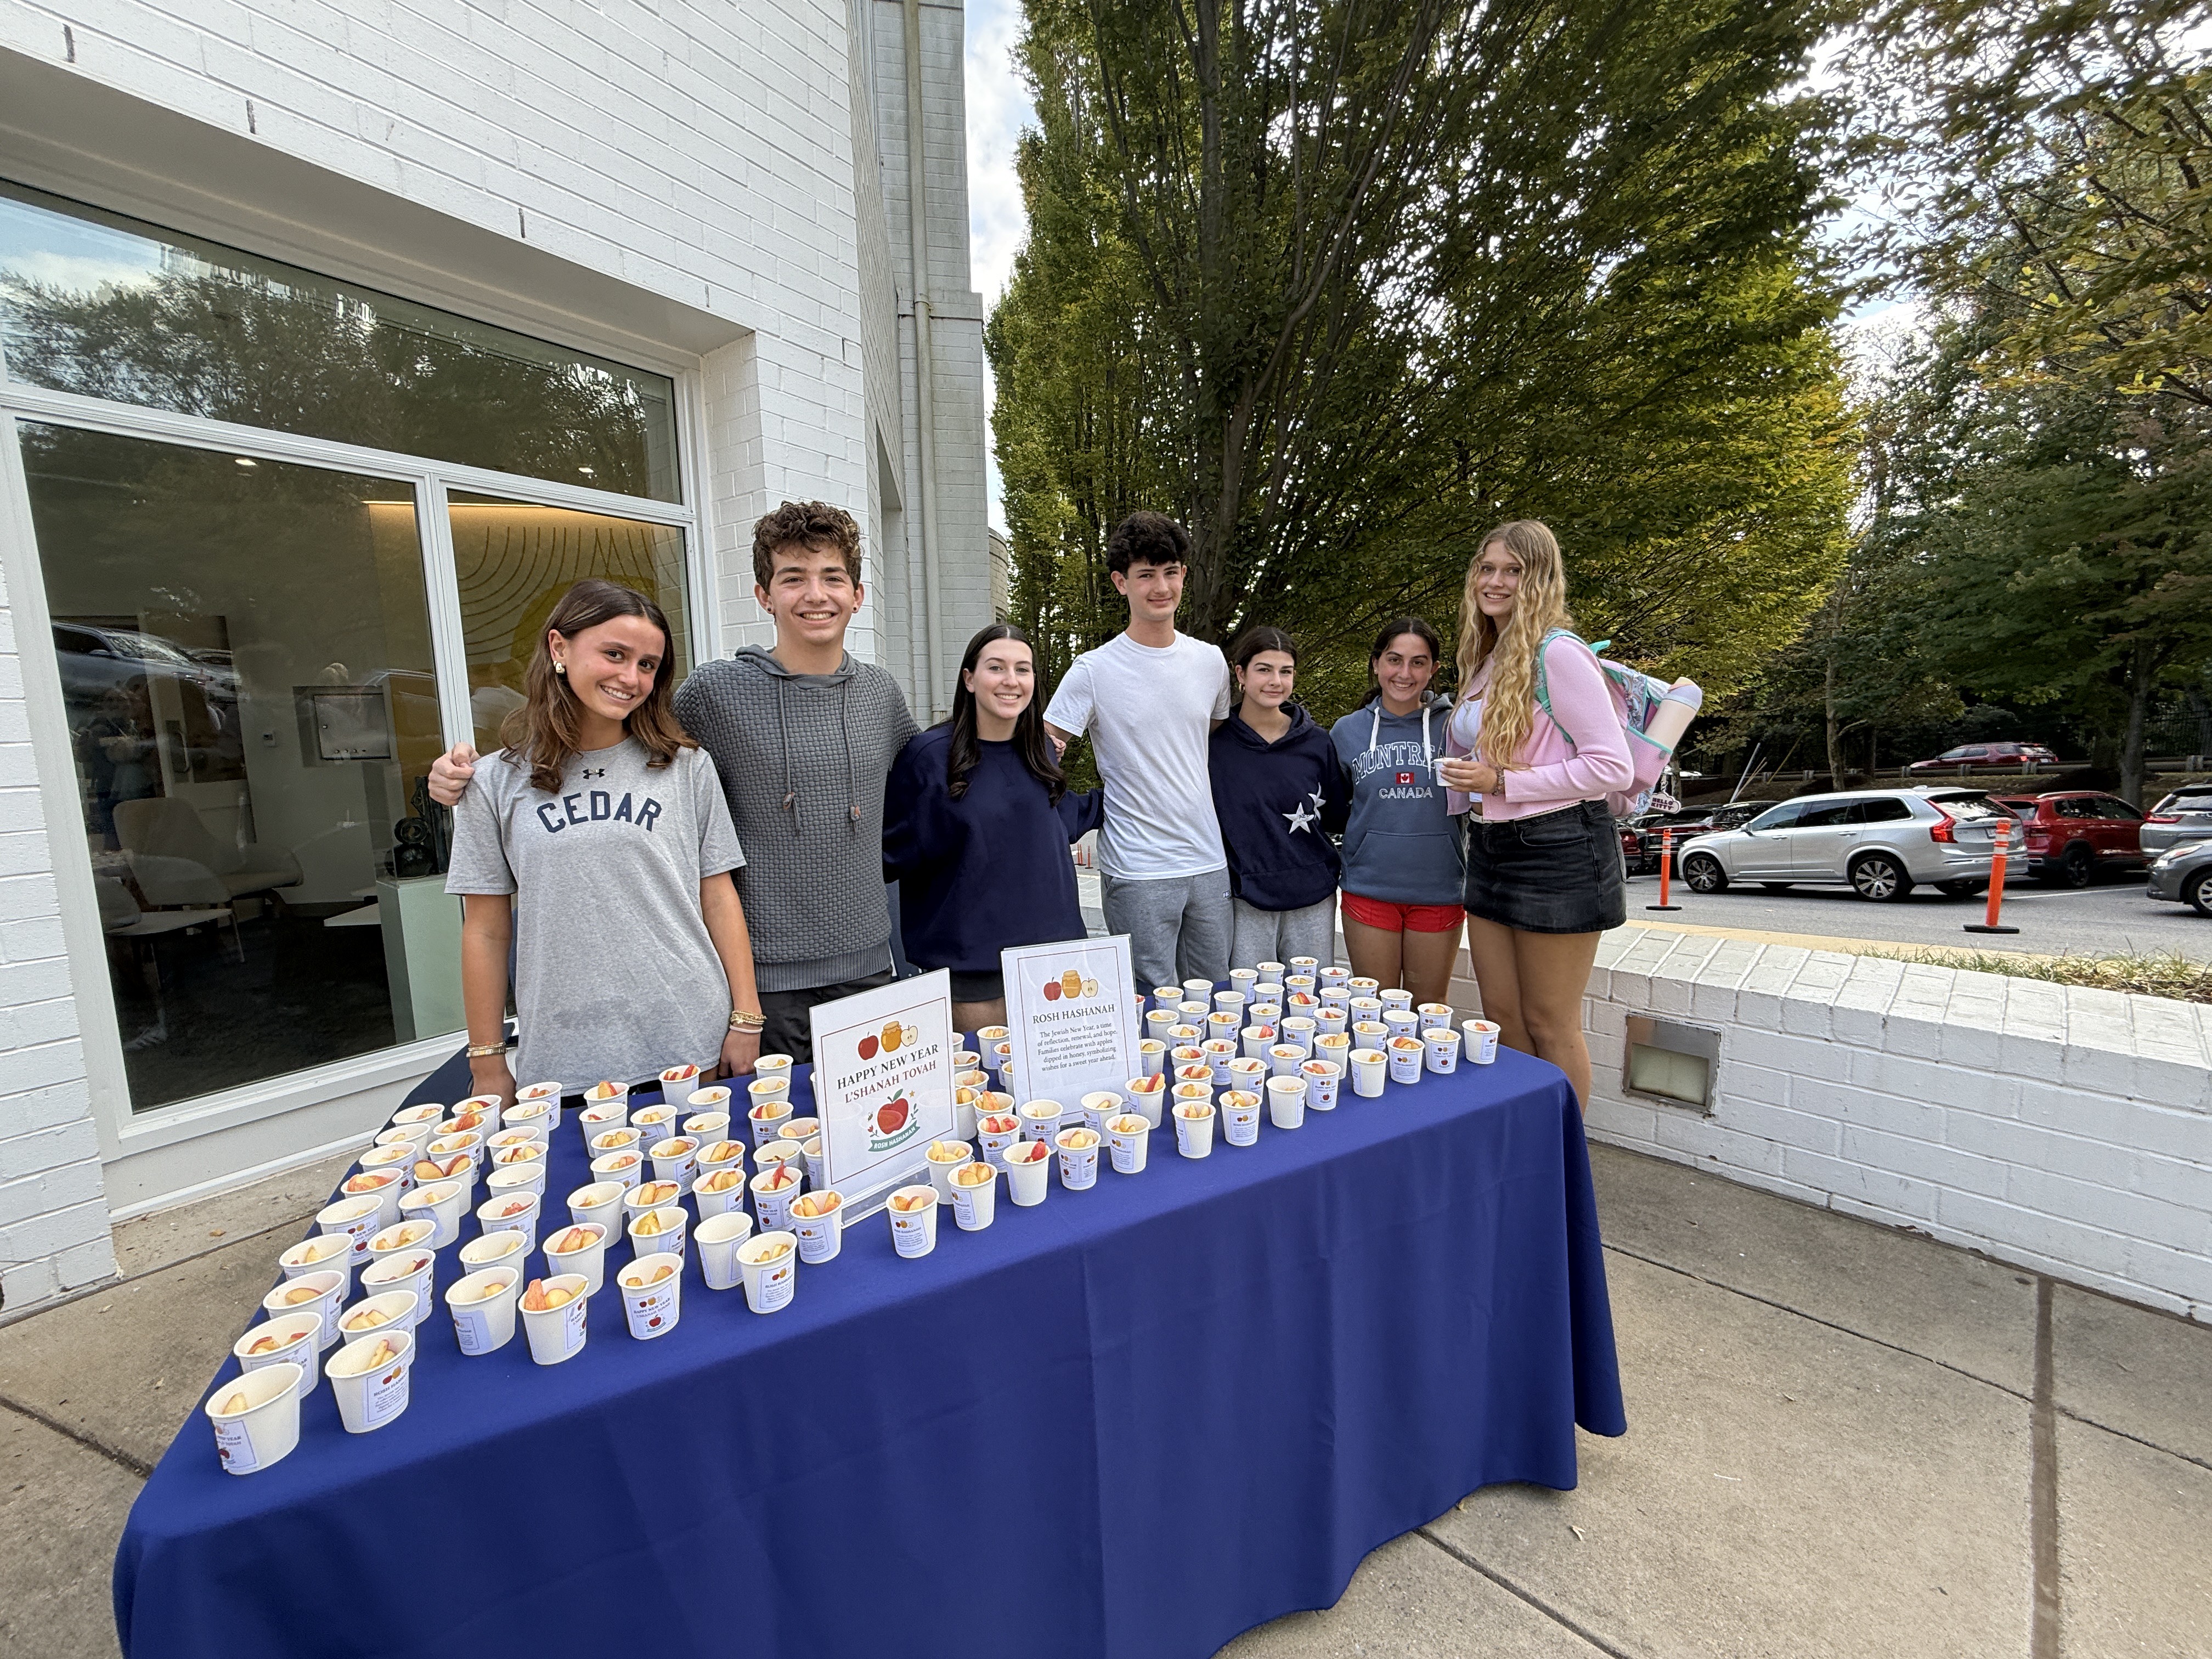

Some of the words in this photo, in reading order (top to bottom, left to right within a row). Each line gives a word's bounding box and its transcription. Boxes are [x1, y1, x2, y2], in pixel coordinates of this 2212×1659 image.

[1352, 741, 1445, 785] MONTRE
[1379, 787, 1433, 799] CANADA
[1652, 797, 1673, 805] HELLO
[537, 791, 662, 833] CEDAR
[1651, 802, 1674, 810] KITTY
[1032, 1012, 1060, 1024] ROSH
[1062, 1004, 1115, 1019] HASHANAH
[1051, 1028, 1069, 1037] Jewish
[1037, 1047, 1059, 1056] Families
[1060, 1043, 1084, 1052] celebrate
[1097, 1038, 1113, 1047] apples
[1043, 1054, 1062, 1063] dipped
[1087, 1046, 1116, 1057] symbolizing
[837, 1065, 877, 1089] HAPPY
[881, 1054, 907, 1074] NEW
[910, 1044, 939, 1062] YEAR
[902, 1059, 936, 1080] TOVAH
[1088, 1058, 1099, 1066] year
[374, 1386, 390, 1397] ROSH
